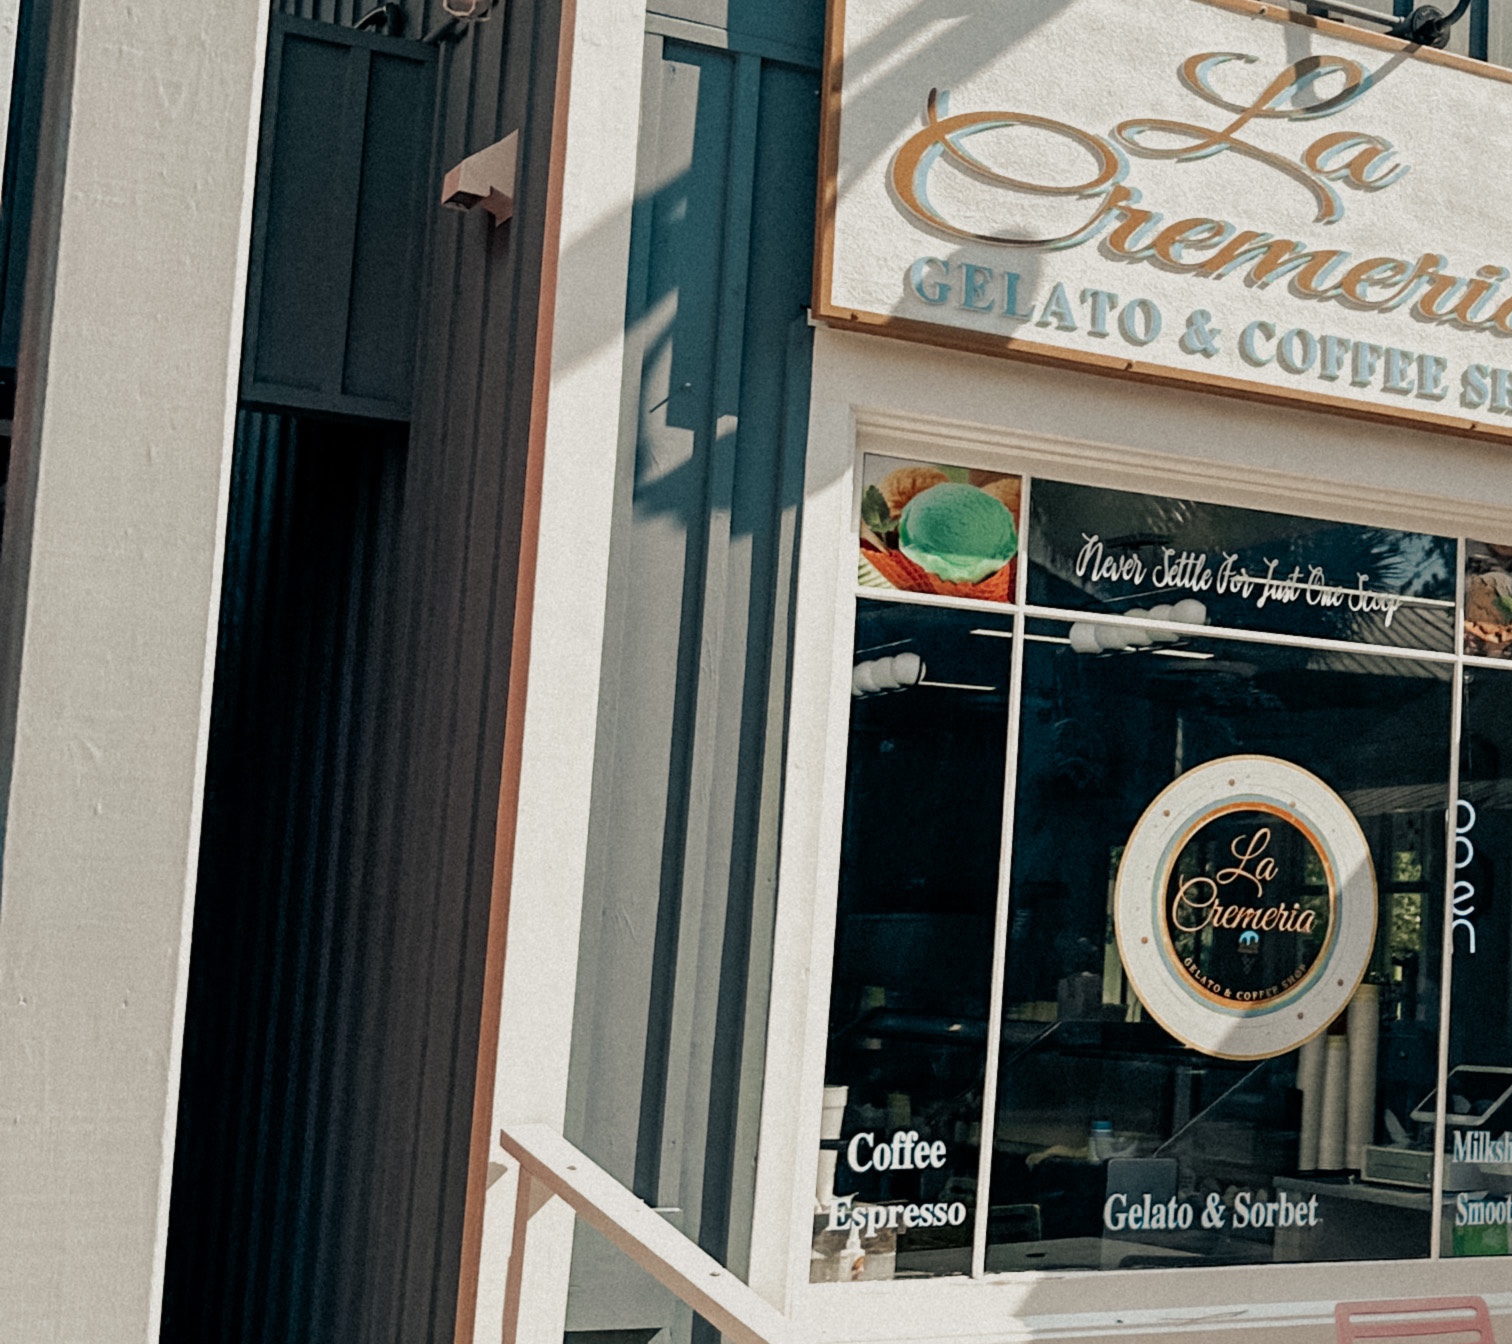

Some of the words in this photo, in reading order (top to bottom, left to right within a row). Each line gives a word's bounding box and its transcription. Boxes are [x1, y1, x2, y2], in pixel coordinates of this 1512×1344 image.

[1116, 51, 1410, 224] La
[906, 255, 1163, 348] GELATO
[1179, 308, 1222, 358] &
[1238, 319, 1449, 401] COFFEE
[1075, 532, 1147, 585] Never
[1152, 546, 1213, 592] Settle
[1216, 551, 1254, 599] For
[1256, 557, 1304, 608] Just
[1306, 564, 1344, 607] One
[1348, 571, 1402, 628] Scoop
[1216, 827, 1279, 898] La
[1172, 874, 1316, 934] Cremeria
[1183, 957, 1222, 993] GELATO
[1223, 988, 1232, 998] &
[1236, 985, 1279, 1000] COFFEE
[1281, 963, 1306, 989] SHOP
[847, 1130, 947, 1173] Coffee
[825, 1196, 967, 1238] Espresso
[1103, 1193, 1193, 1231] Gelato
[1201, 1192, 1226, 1229] &
[1233, 1191, 1319, 1229] Sorbet
